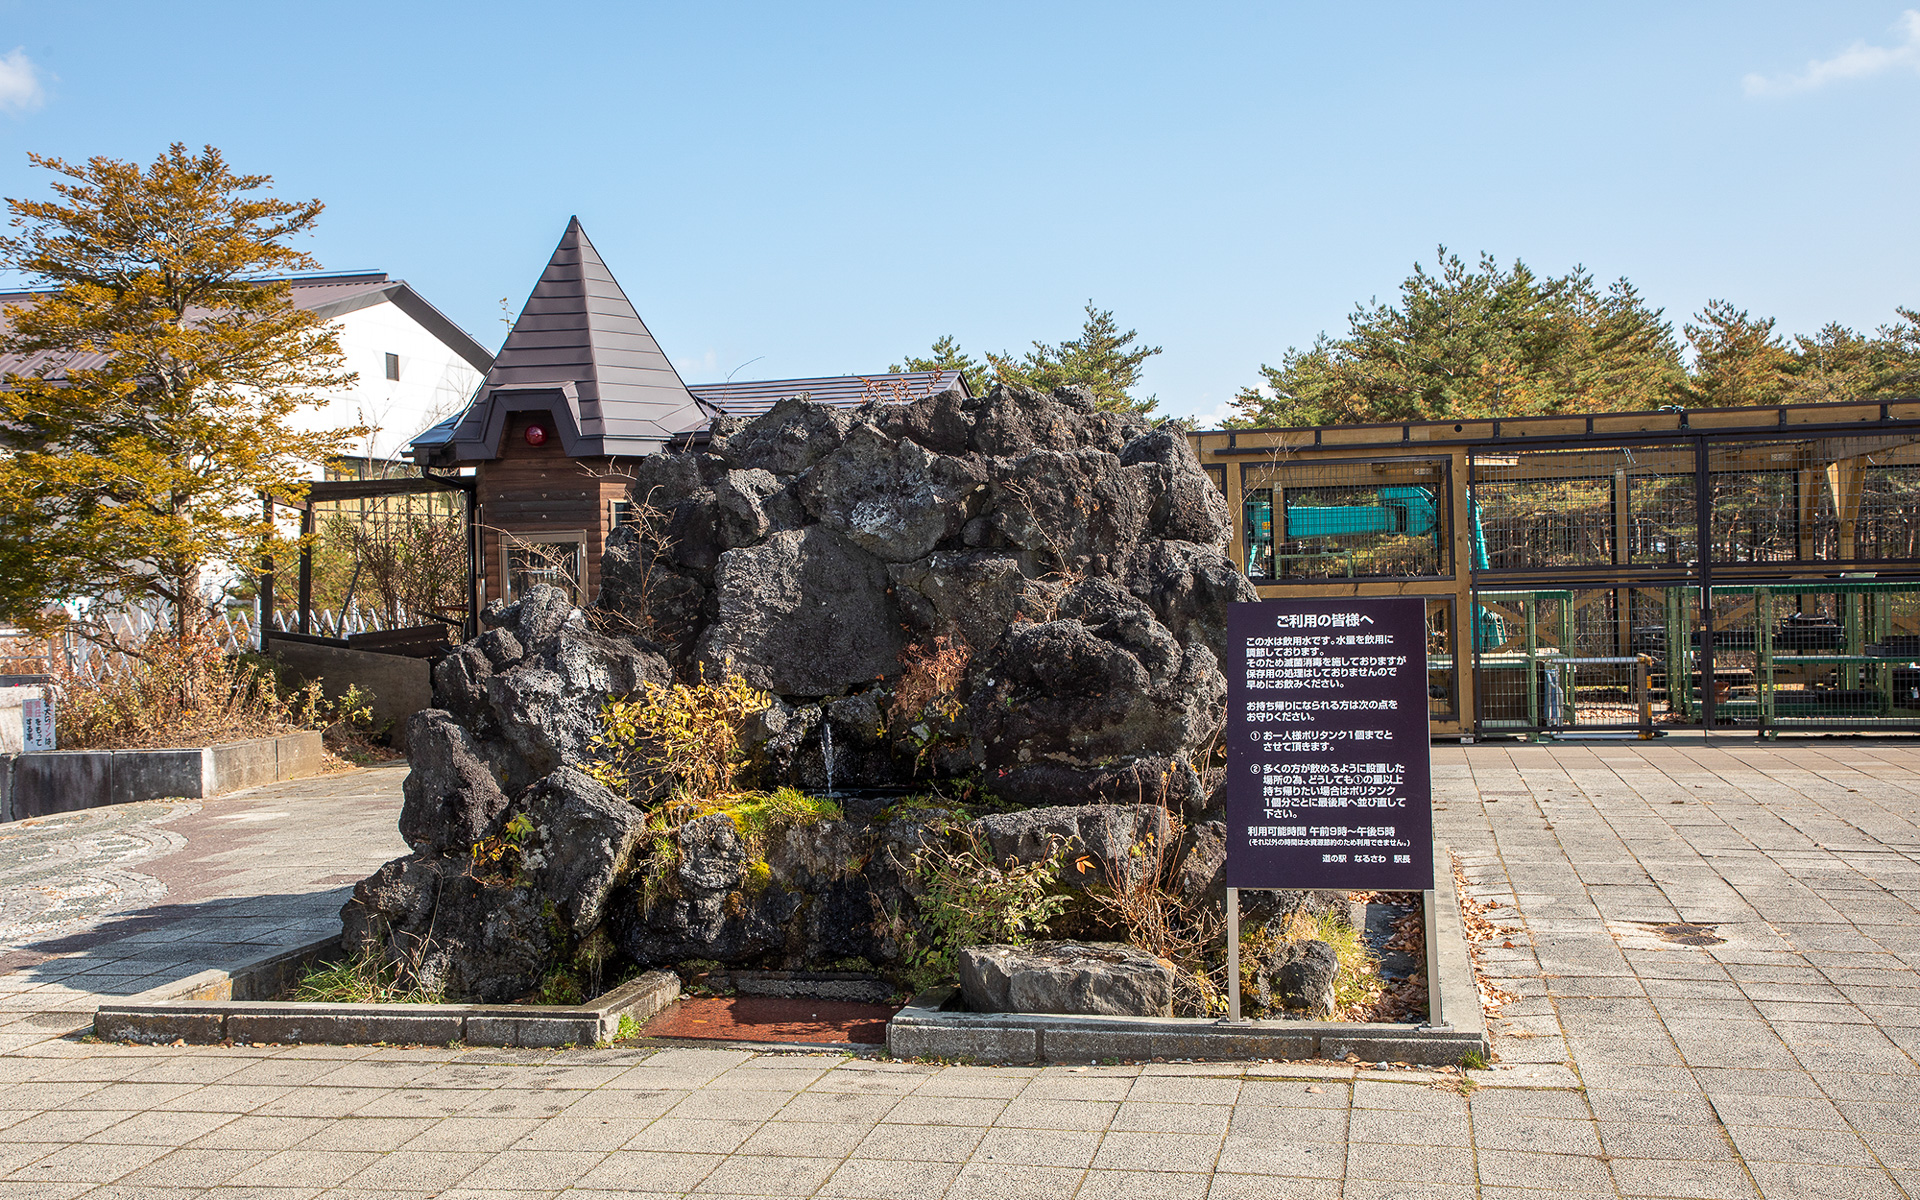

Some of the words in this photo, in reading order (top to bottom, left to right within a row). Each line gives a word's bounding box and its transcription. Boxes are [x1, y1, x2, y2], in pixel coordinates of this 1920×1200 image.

[1276, 613, 1374, 628] ご利用の皆様へ
[1246, 635, 1394, 647] この水は飲用水です。水量を飲用に
[1246, 647, 1325, 658] 調節しております。
[1246, 656, 1407, 669] そのため滅菌消毒を施しておりますが
[1246, 667, 1397, 680] 保存用の処理はしておりませんので
[1246, 678, 1345, 690] 早めにお飲みください。
[1246, 700, 1397, 711] お持ち帰りになられる方は次の点を
[1246, 711, 1315, 723] お守りください。
[1263, 730, 1393, 742] お一人様ポリタンク1個までと
[1263, 741, 1335, 752] させて頂きます。
[1263, 763, 1405, 774] 多くの方が飲めるように設置した
[1262, 774, 1404, 786] 場所の為、どうしても①の量以上
[1262, 785, 1396, 797] 持ち帰りたい場合はポリタンク
[1264, 797, 1407, 808] 1個分ごとに最後尾へ並び直して
[1263, 808, 1298, 820] 下さい。
[1247, 826, 1307, 837] 利用可能時間
[1322, 853, 1348, 864] 道の駅
[1354, 854, 1386, 864] なるさわ
[1393, 854, 1411, 865] 駅長
